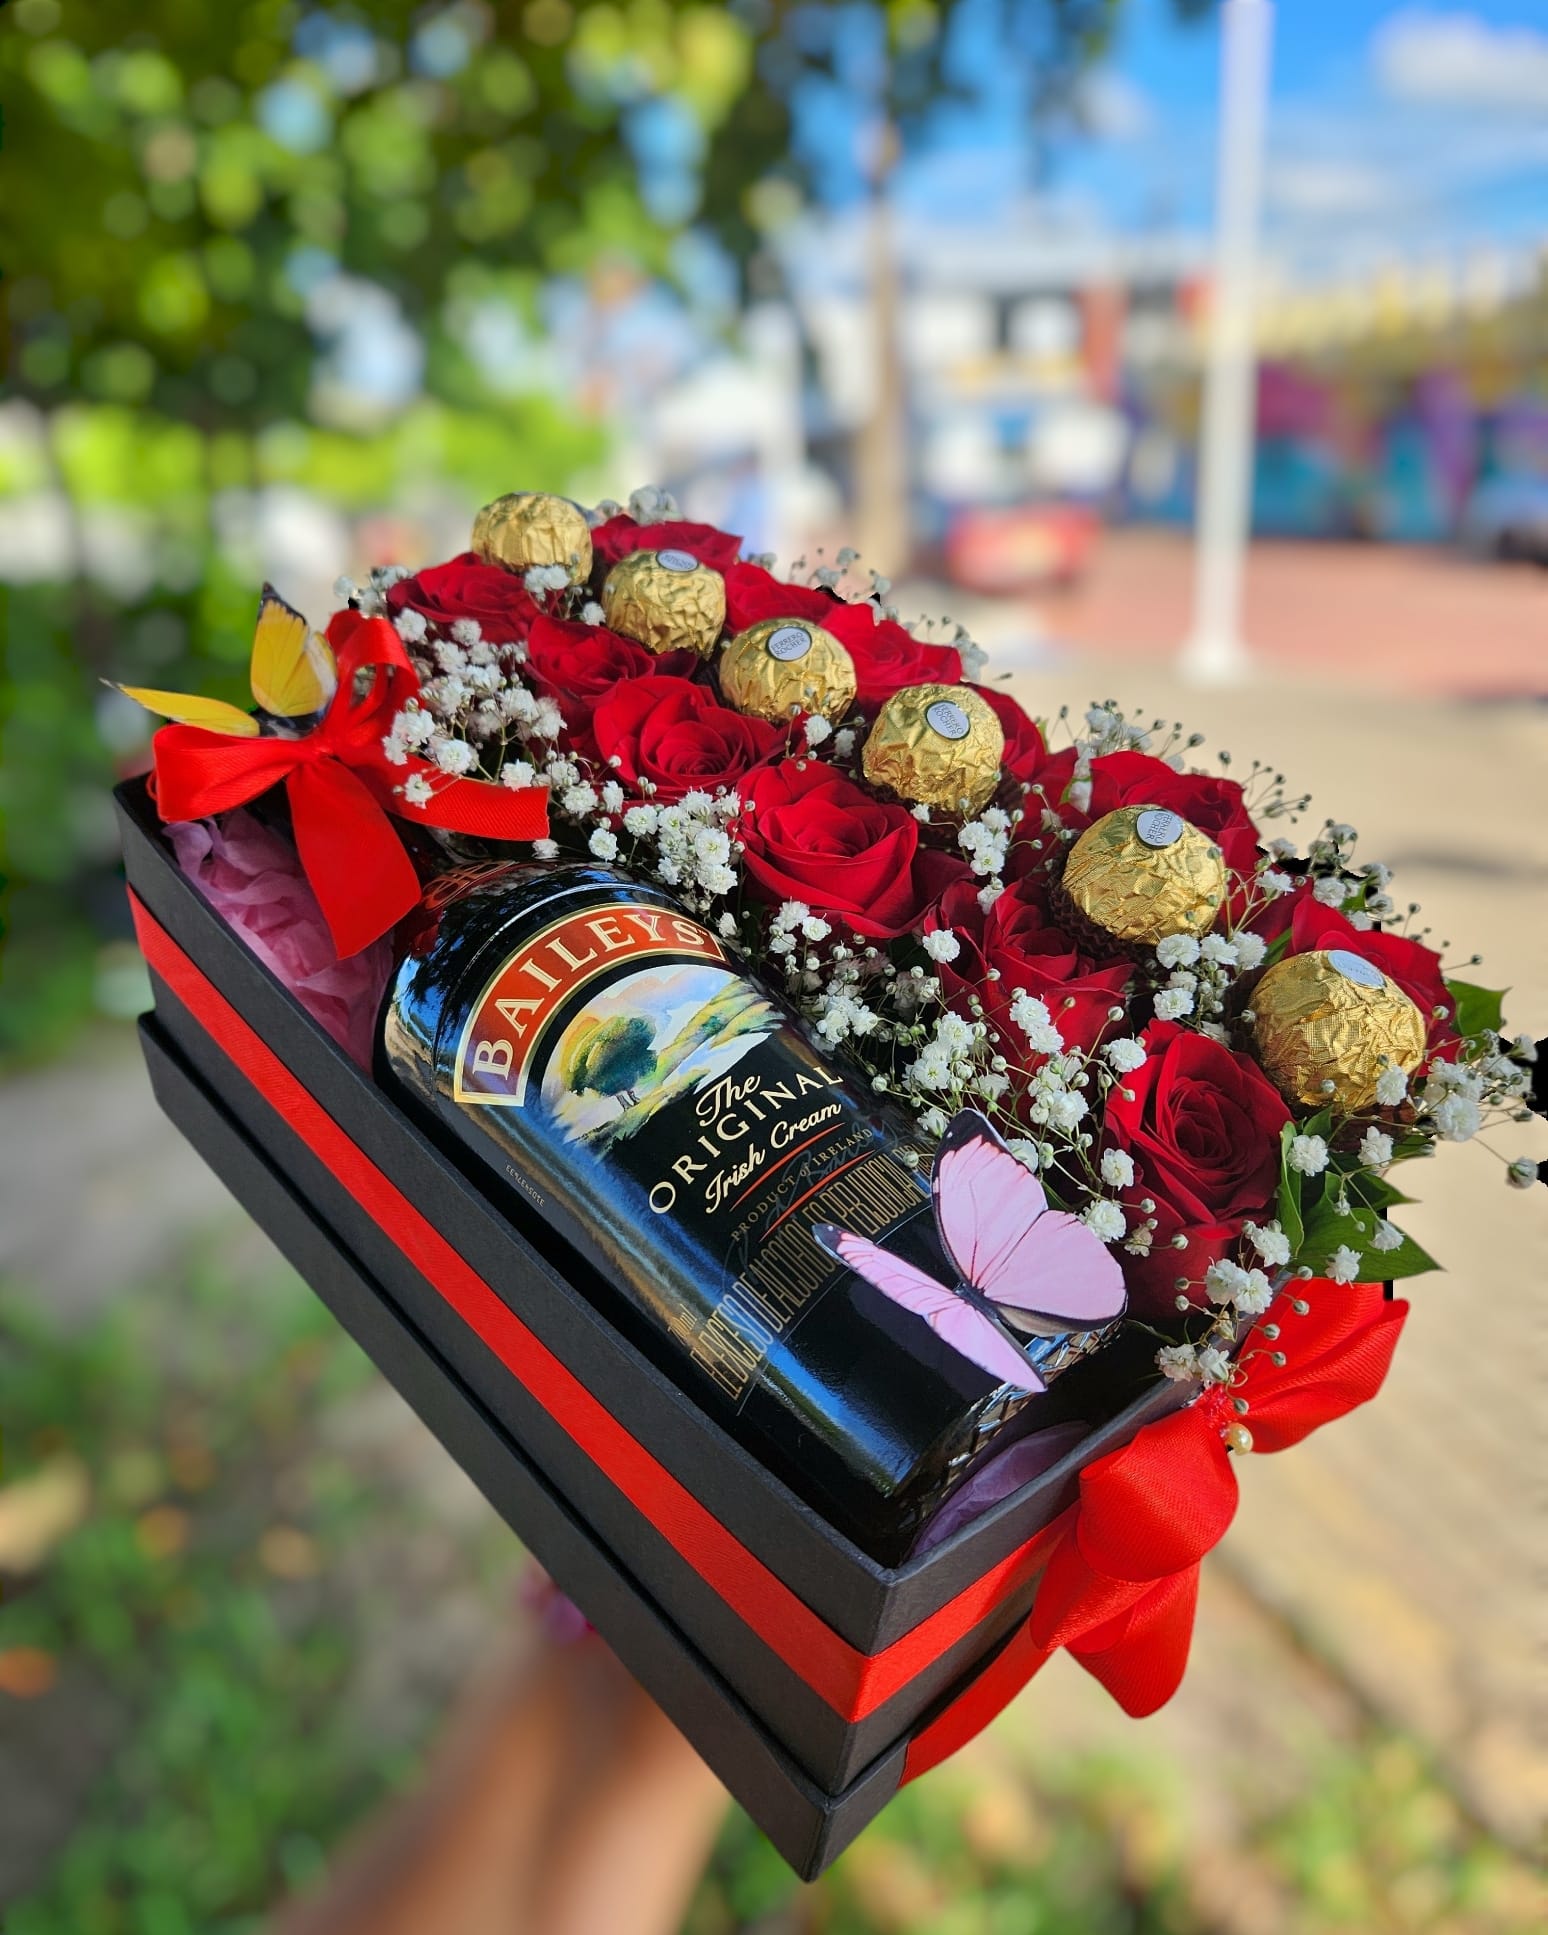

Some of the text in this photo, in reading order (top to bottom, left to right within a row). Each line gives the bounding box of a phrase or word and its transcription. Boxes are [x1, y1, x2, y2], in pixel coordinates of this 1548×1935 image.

[472, 913, 705, 1080] BAILEYS
[649, 1066, 844, 1215] ORIGINAL
[696, 1075, 761, 1127] The
[705, 1103, 842, 1214] Irish Cream
[731, 1175, 796, 1241] PRODUCT
[813, 1128, 873, 1166] IRELAND
[819, 1153, 931, 1237] PERJUDICIAL
[732, 1272, 792, 1333] DE
[749, 1219, 840, 1315] ALCOHOL
[690, 1347, 743, 1400] EL
[698, 1294, 774, 1383] EXCESO
